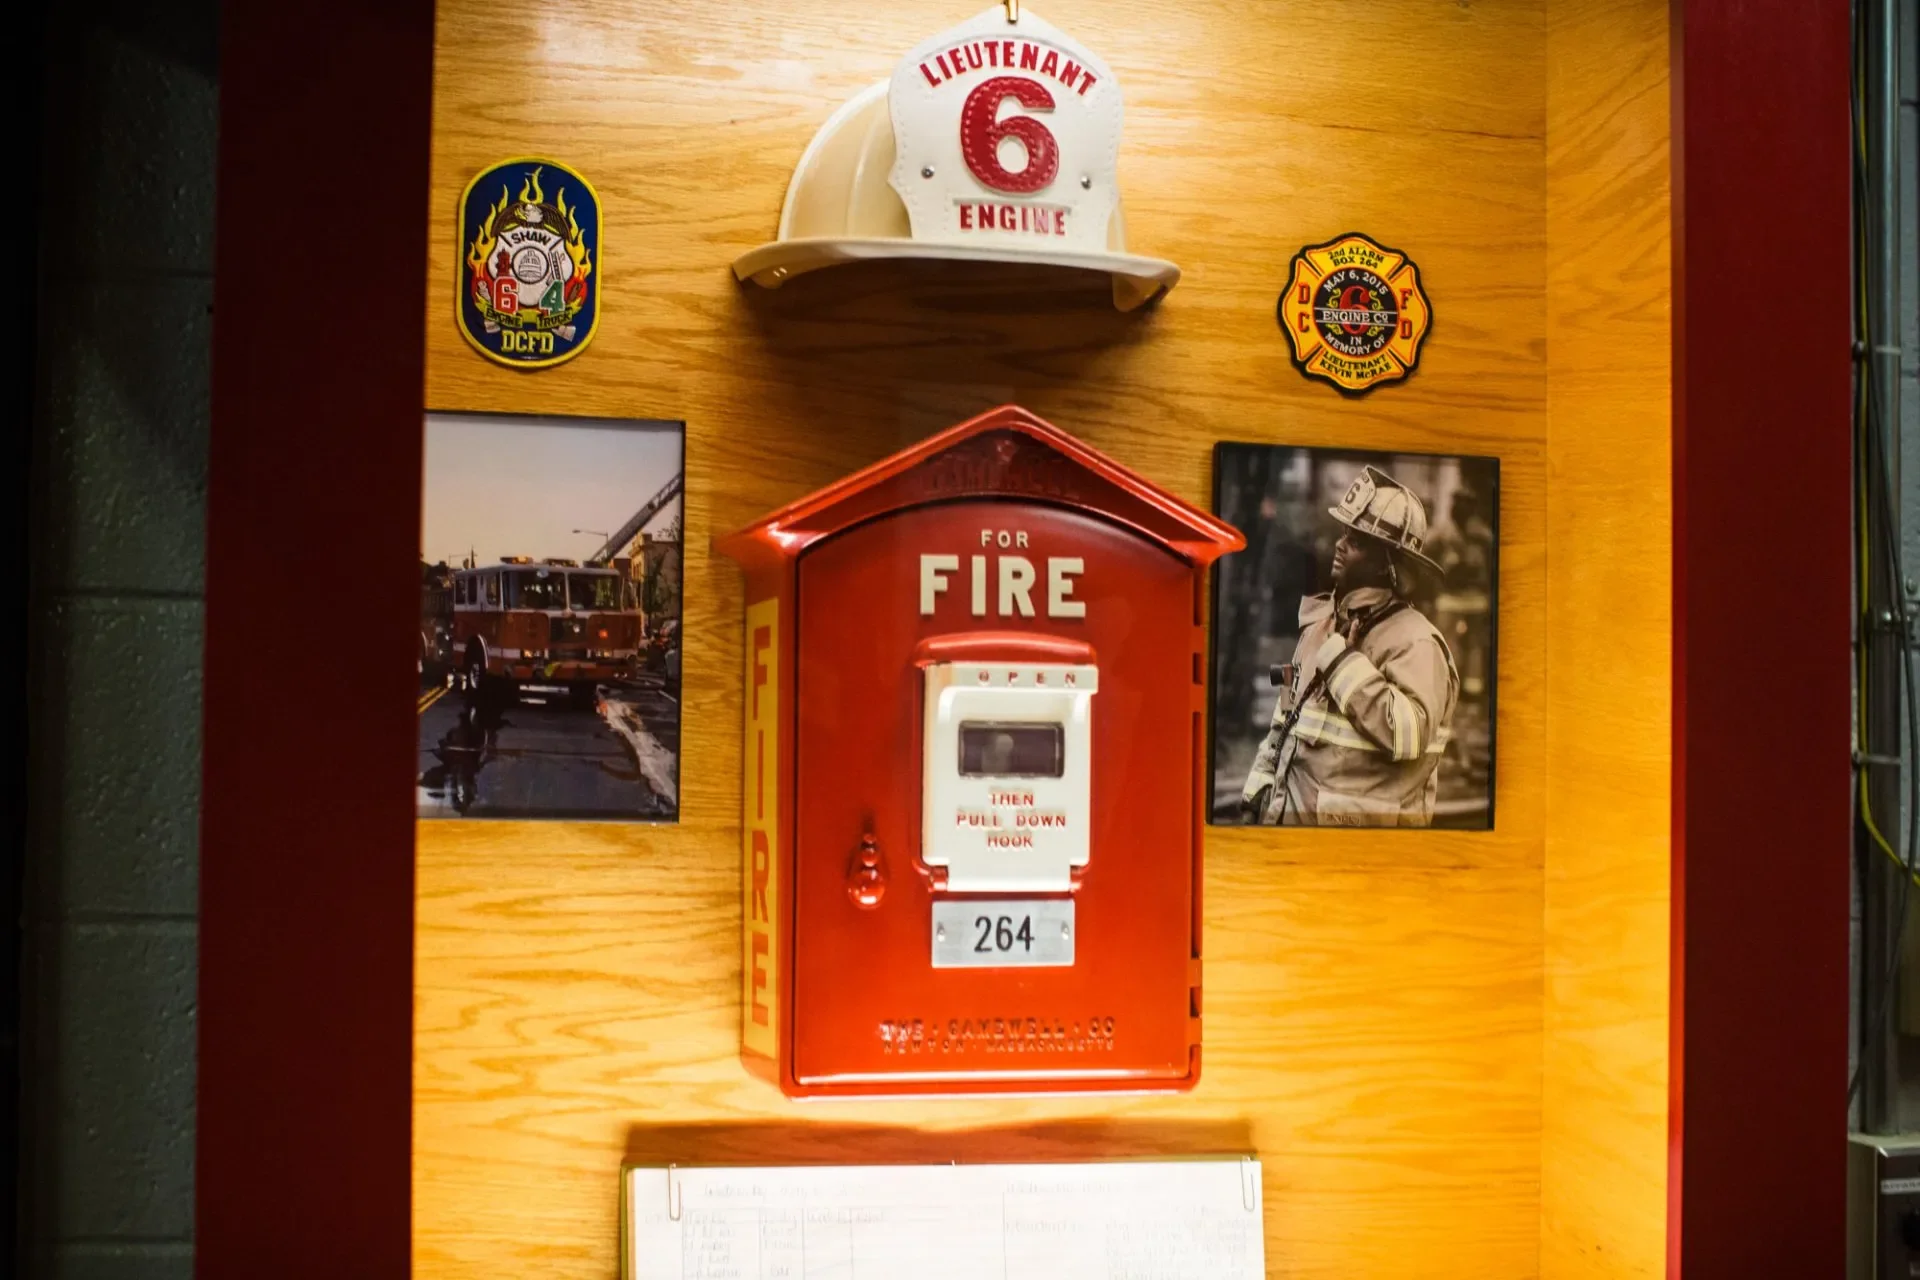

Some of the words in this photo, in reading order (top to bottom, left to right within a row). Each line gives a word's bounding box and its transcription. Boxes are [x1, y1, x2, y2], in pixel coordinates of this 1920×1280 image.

[920, 41, 1096, 95] LIEUTENANT
[961, 76, 1059, 193] 6
[960, 204, 1065, 235] ENGINE
[511, 231, 551, 246] SHAW
[1333, 257, 1355, 267] BOX
[1360, 257, 1378, 269] 264
[1349, 248, 1384, 263] ALARM
[1323, 271, 1345, 291] MAY
[1349, 270, 1359, 280] 6,
[1363, 272, 1388, 295] 2015
[494, 276, 518, 315] 6
[540, 280, 565, 316] 4
[538, 307, 571, 328] TRUCK
[1322, 311, 1370, 324] ENGINE
[501, 330, 554, 354] DCFD
[1325, 332, 1370, 355] MEMORY
[1373, 333, 1384, 348] OF
[1350, 336, 1362, 345] IN
[1320, 359, 1351, 378] KEVIN
[1323, 350, 1386, 370] LIEUTENANT
[981, 529, 1029, 548] FOR
[920, 554, 1086, 617] FIRE
[979, 671, 1076, 684] OPEN
[991, 794, 1034, 806] THEN
[752, 625, 771, 1026] FIRE
[957, 815, 1001, 826] PULL
[1016, 815, 1065, 826] DOWN
[988, 836, 1033, 847] HOOK
[974, 916, 1035, 952] 264
